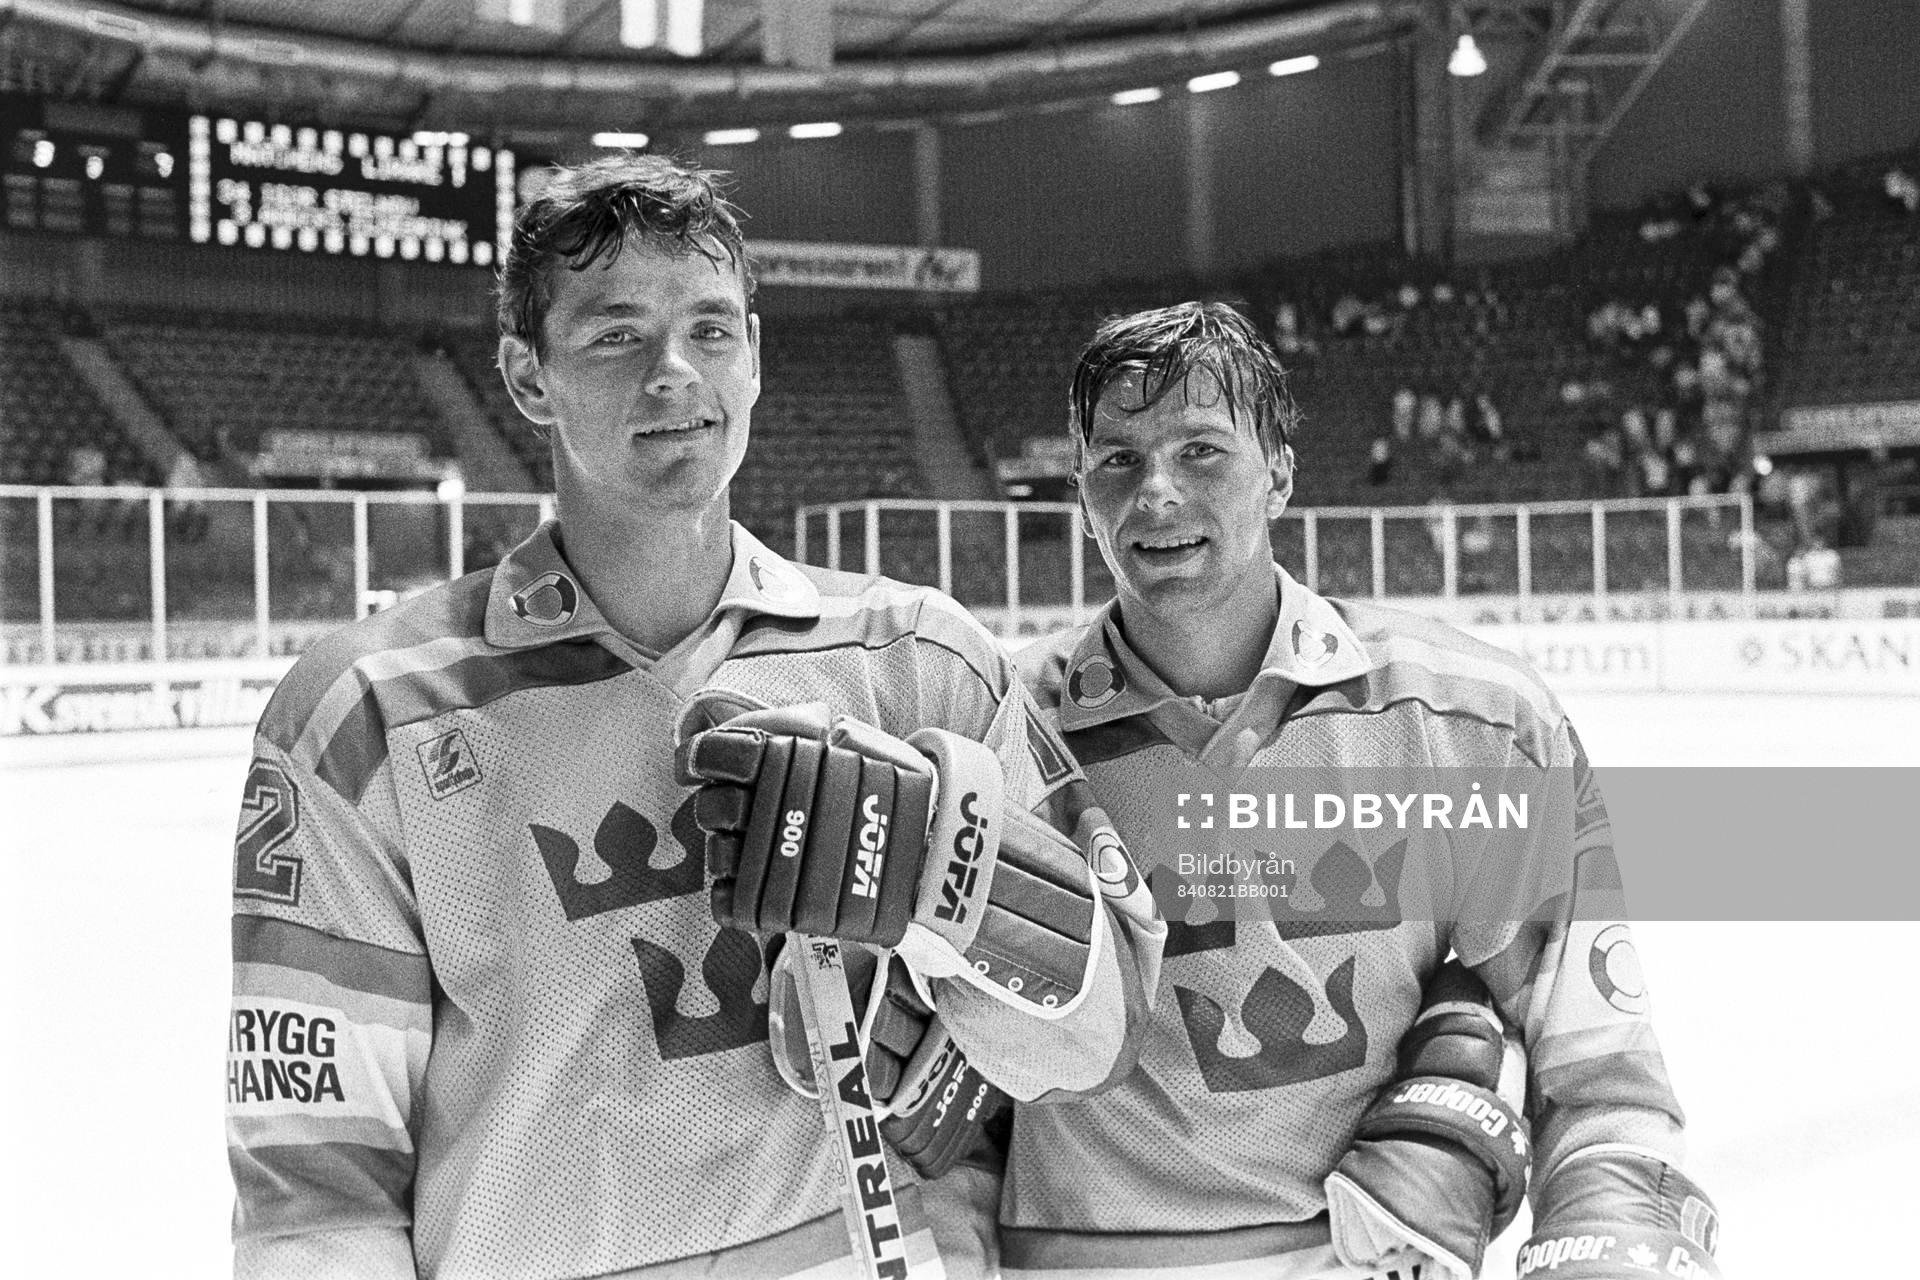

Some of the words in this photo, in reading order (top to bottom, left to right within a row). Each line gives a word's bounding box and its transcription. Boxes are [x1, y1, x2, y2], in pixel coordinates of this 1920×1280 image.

[780, 809, 805, 858] 900
[851, 794, 888, 899] JOFA
[935, 791, 988, 924] JOFA
[1393, 1083, 1508, 1137] Cooper
